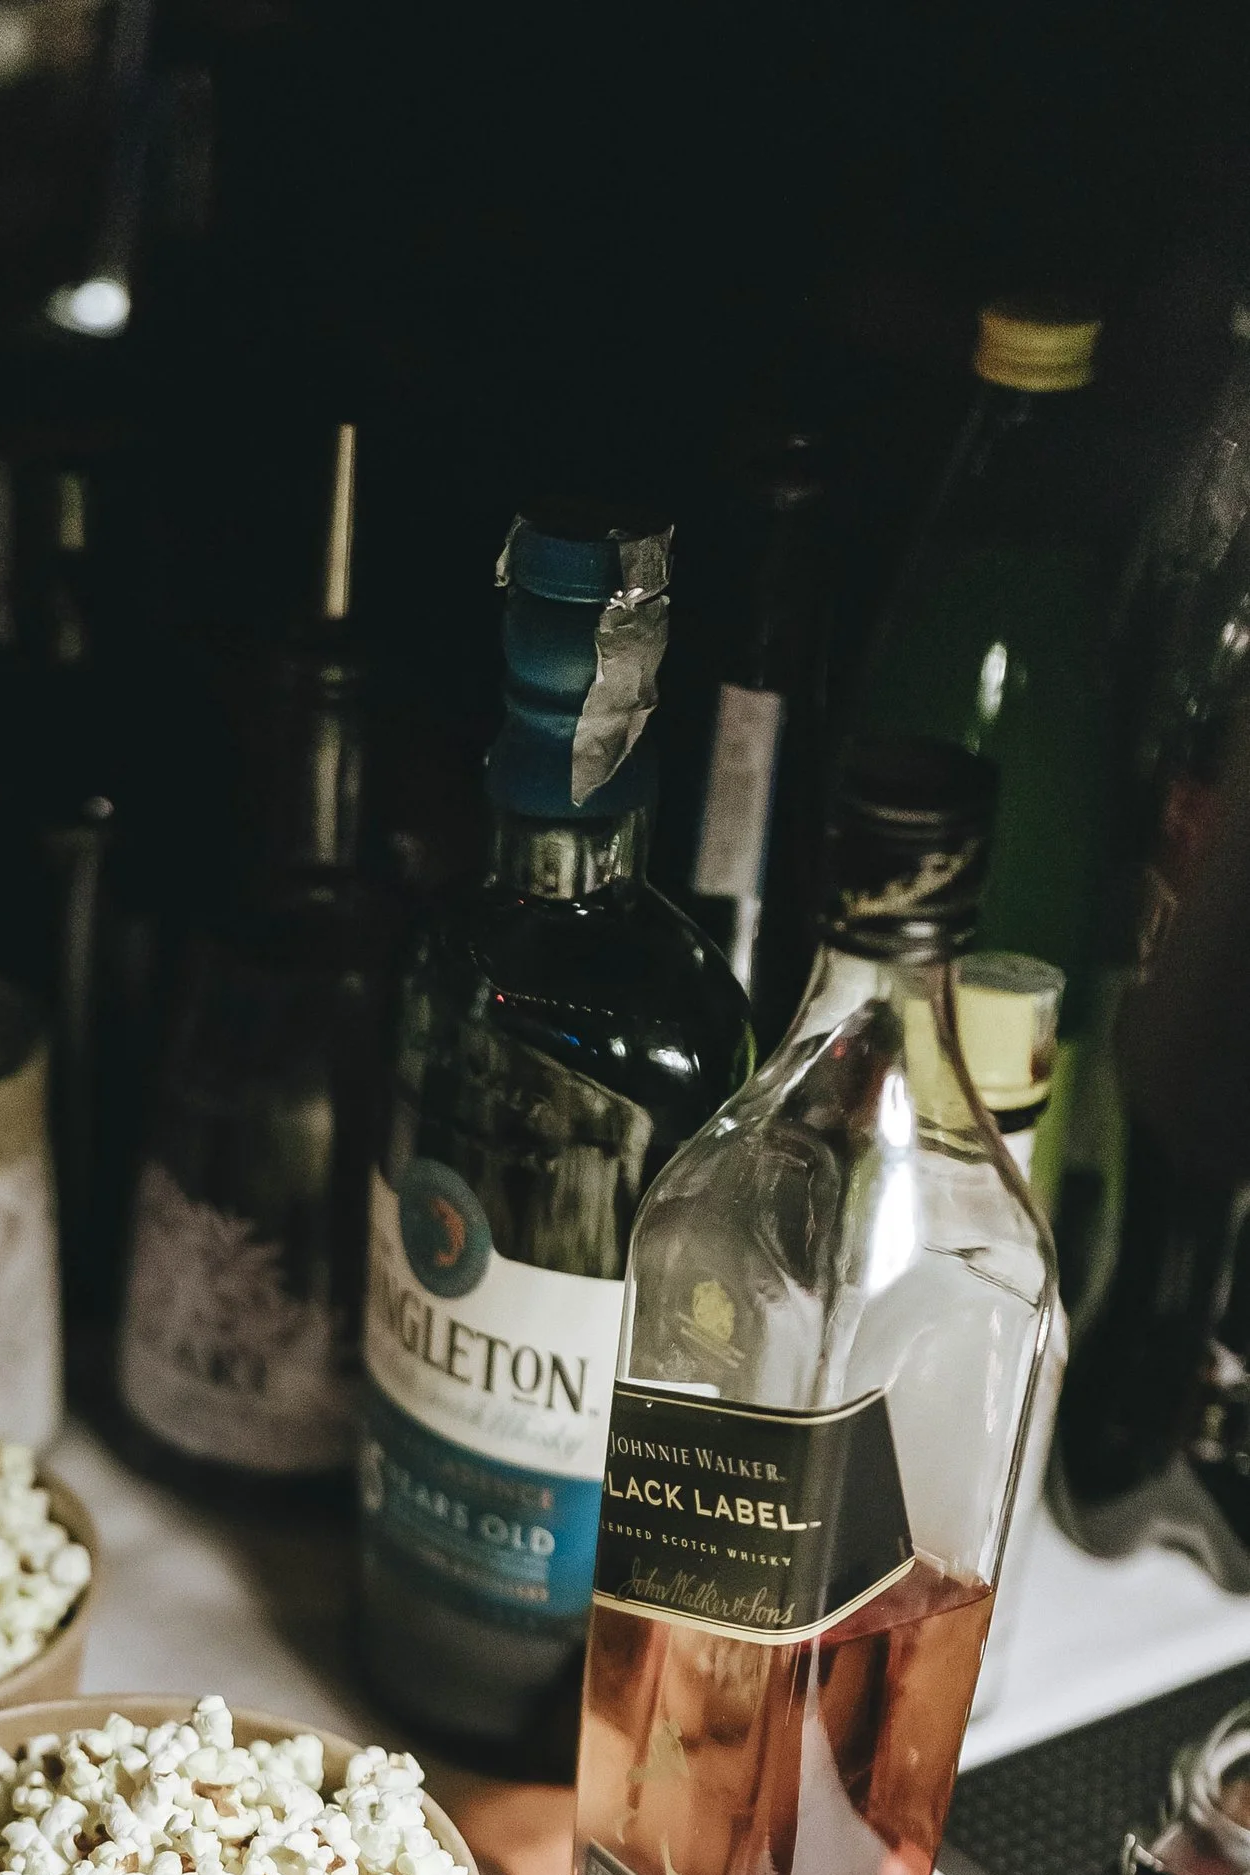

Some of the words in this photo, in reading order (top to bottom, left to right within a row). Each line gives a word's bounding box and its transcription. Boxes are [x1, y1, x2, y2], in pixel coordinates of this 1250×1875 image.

[609, 1431, 691, 1466] JOHNNIE
[694, 1447, 779, 1482] WALKER
[603, 1470, 685, 1511] LACK
[694, 1488, 808, 1531] LABEL
[479, 1514, 556, 1557] OLD
[600, 1519, 653, 1541] LENDED
[661, 1533, 717, 1555] SCOTCH
[726, 1548, 792, 1568] WHISKY
[671, 1568, 730, 1615] Walker
[742, 1586, 796, 1625] Sons
